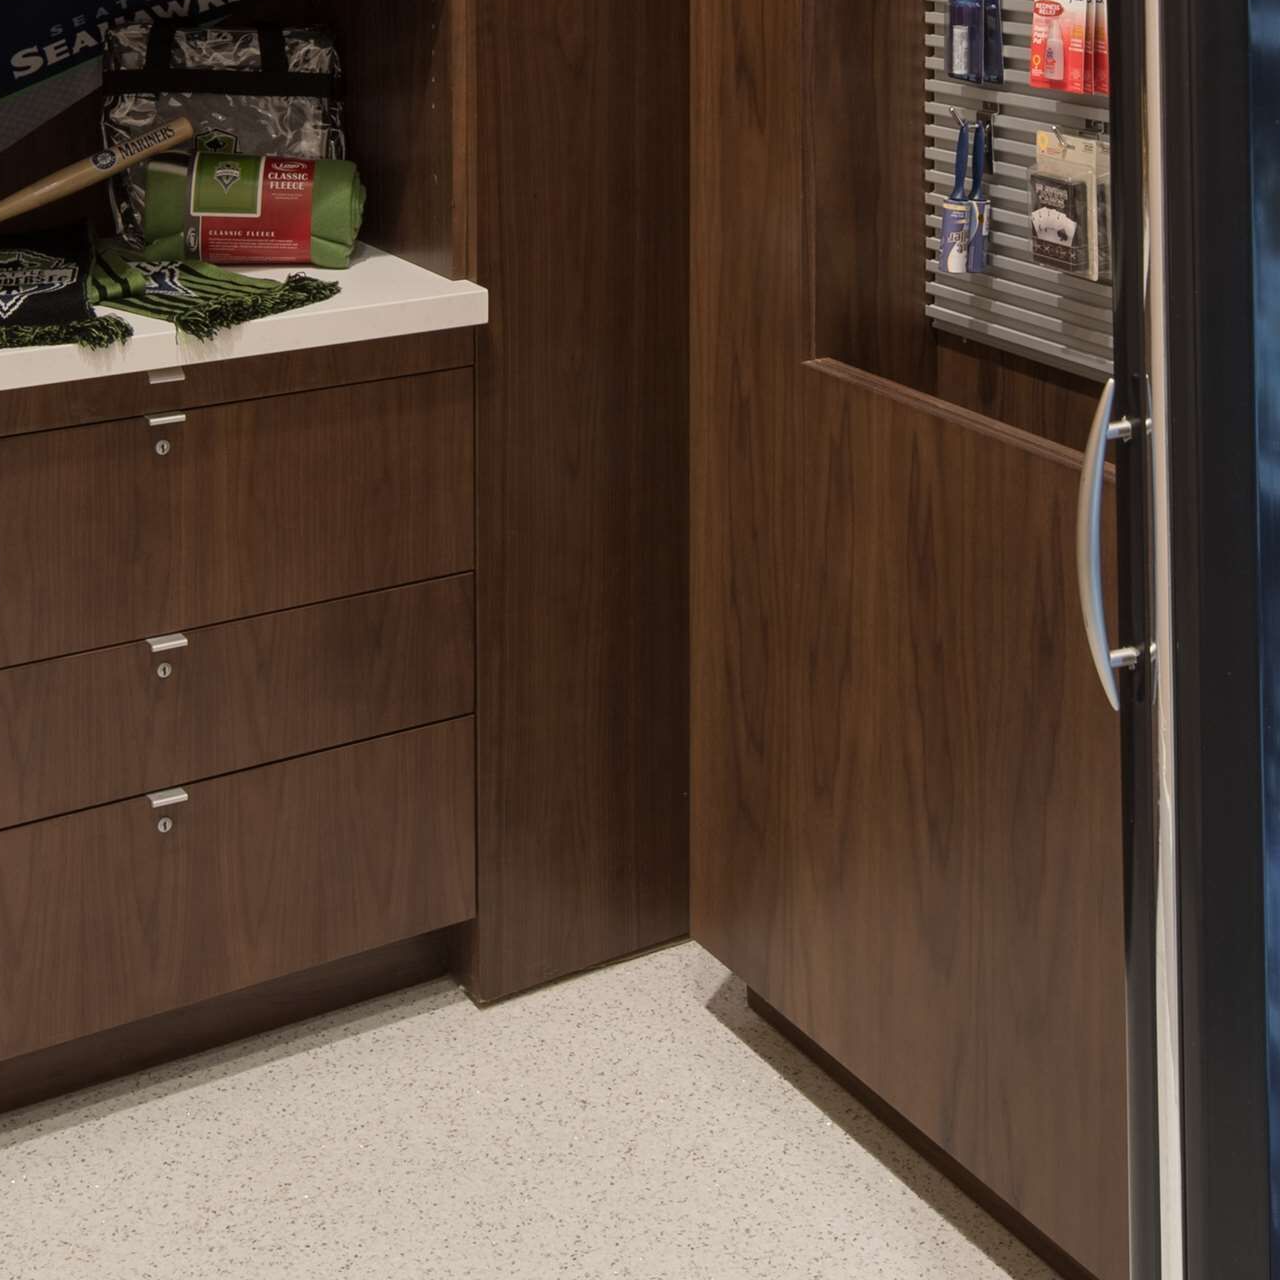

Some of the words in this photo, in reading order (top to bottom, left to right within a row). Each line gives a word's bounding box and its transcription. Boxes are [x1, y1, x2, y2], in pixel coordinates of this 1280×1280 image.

[120, 126, 175, 160] MARINERS
[268, 172, 309, 181] CLASSIC
[270, 181, 306, 190] FLEECE
